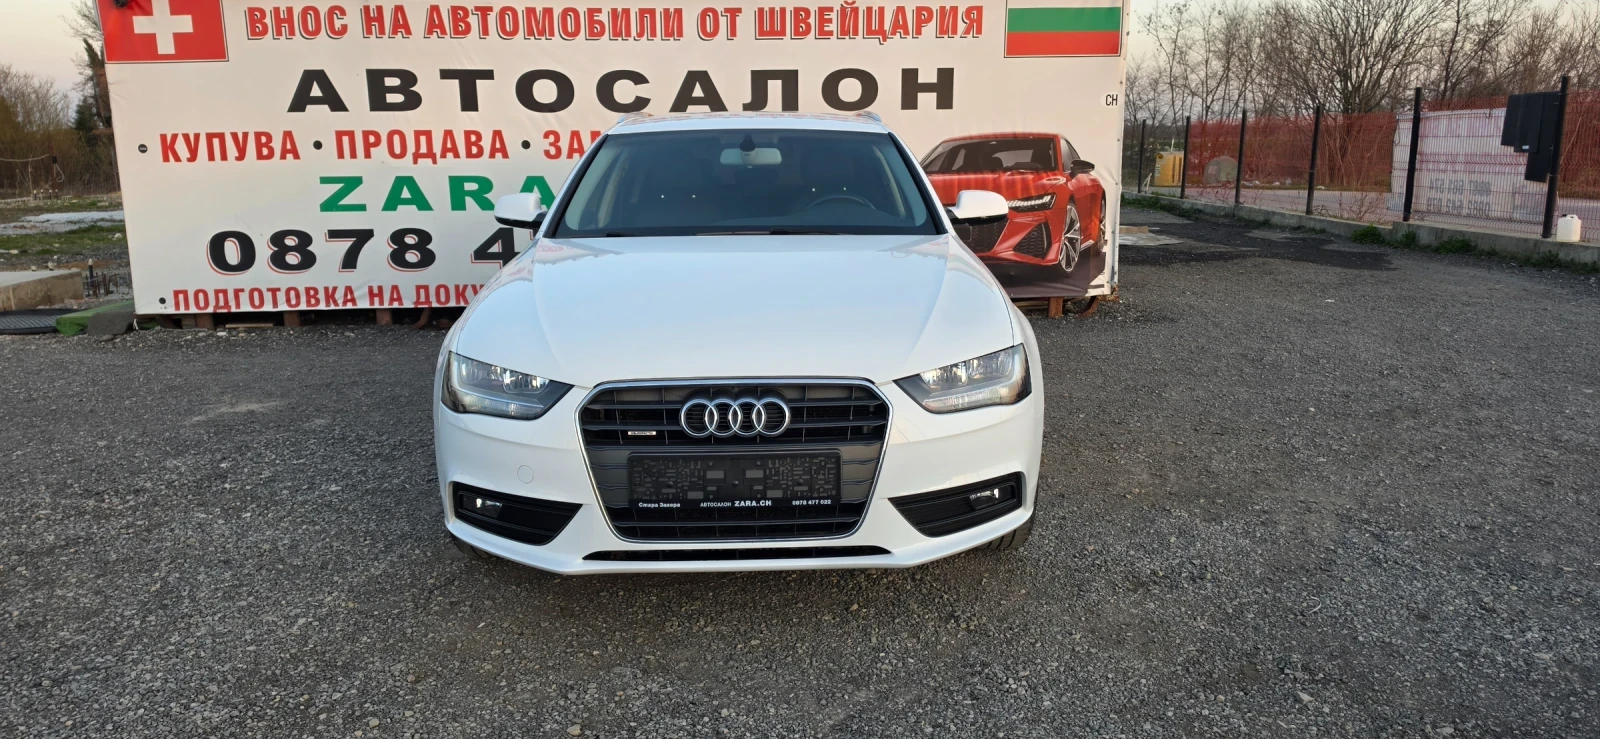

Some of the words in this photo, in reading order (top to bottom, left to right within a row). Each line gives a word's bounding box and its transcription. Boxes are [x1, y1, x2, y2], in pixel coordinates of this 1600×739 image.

[247, 5, 350, 40] ВНОС
[362, 4, 413, 39] НА
[422, 4, 685, 41] АВТОМОБИЛИ
[697, 7, 744, 41] ОТ
[752, 3, 984, 45] ШВЕЙЦАРИЯ
[287, 67, 955, 112] АВТОСАЛОН
[1105, 94, 1118, 107] CH
[159, 130, 301, 163] КУПУВА
[335, 129, 509, 165] ПРОДАВА
[319, 175, 556, 213] ZARA
[206, 227, 438, 275] 0878
[173, 285, 357, 313] ПОДГОТОВКА
[368, 285, 403, 307] НА
[734, 499, 772, 507] ZARA.CH
